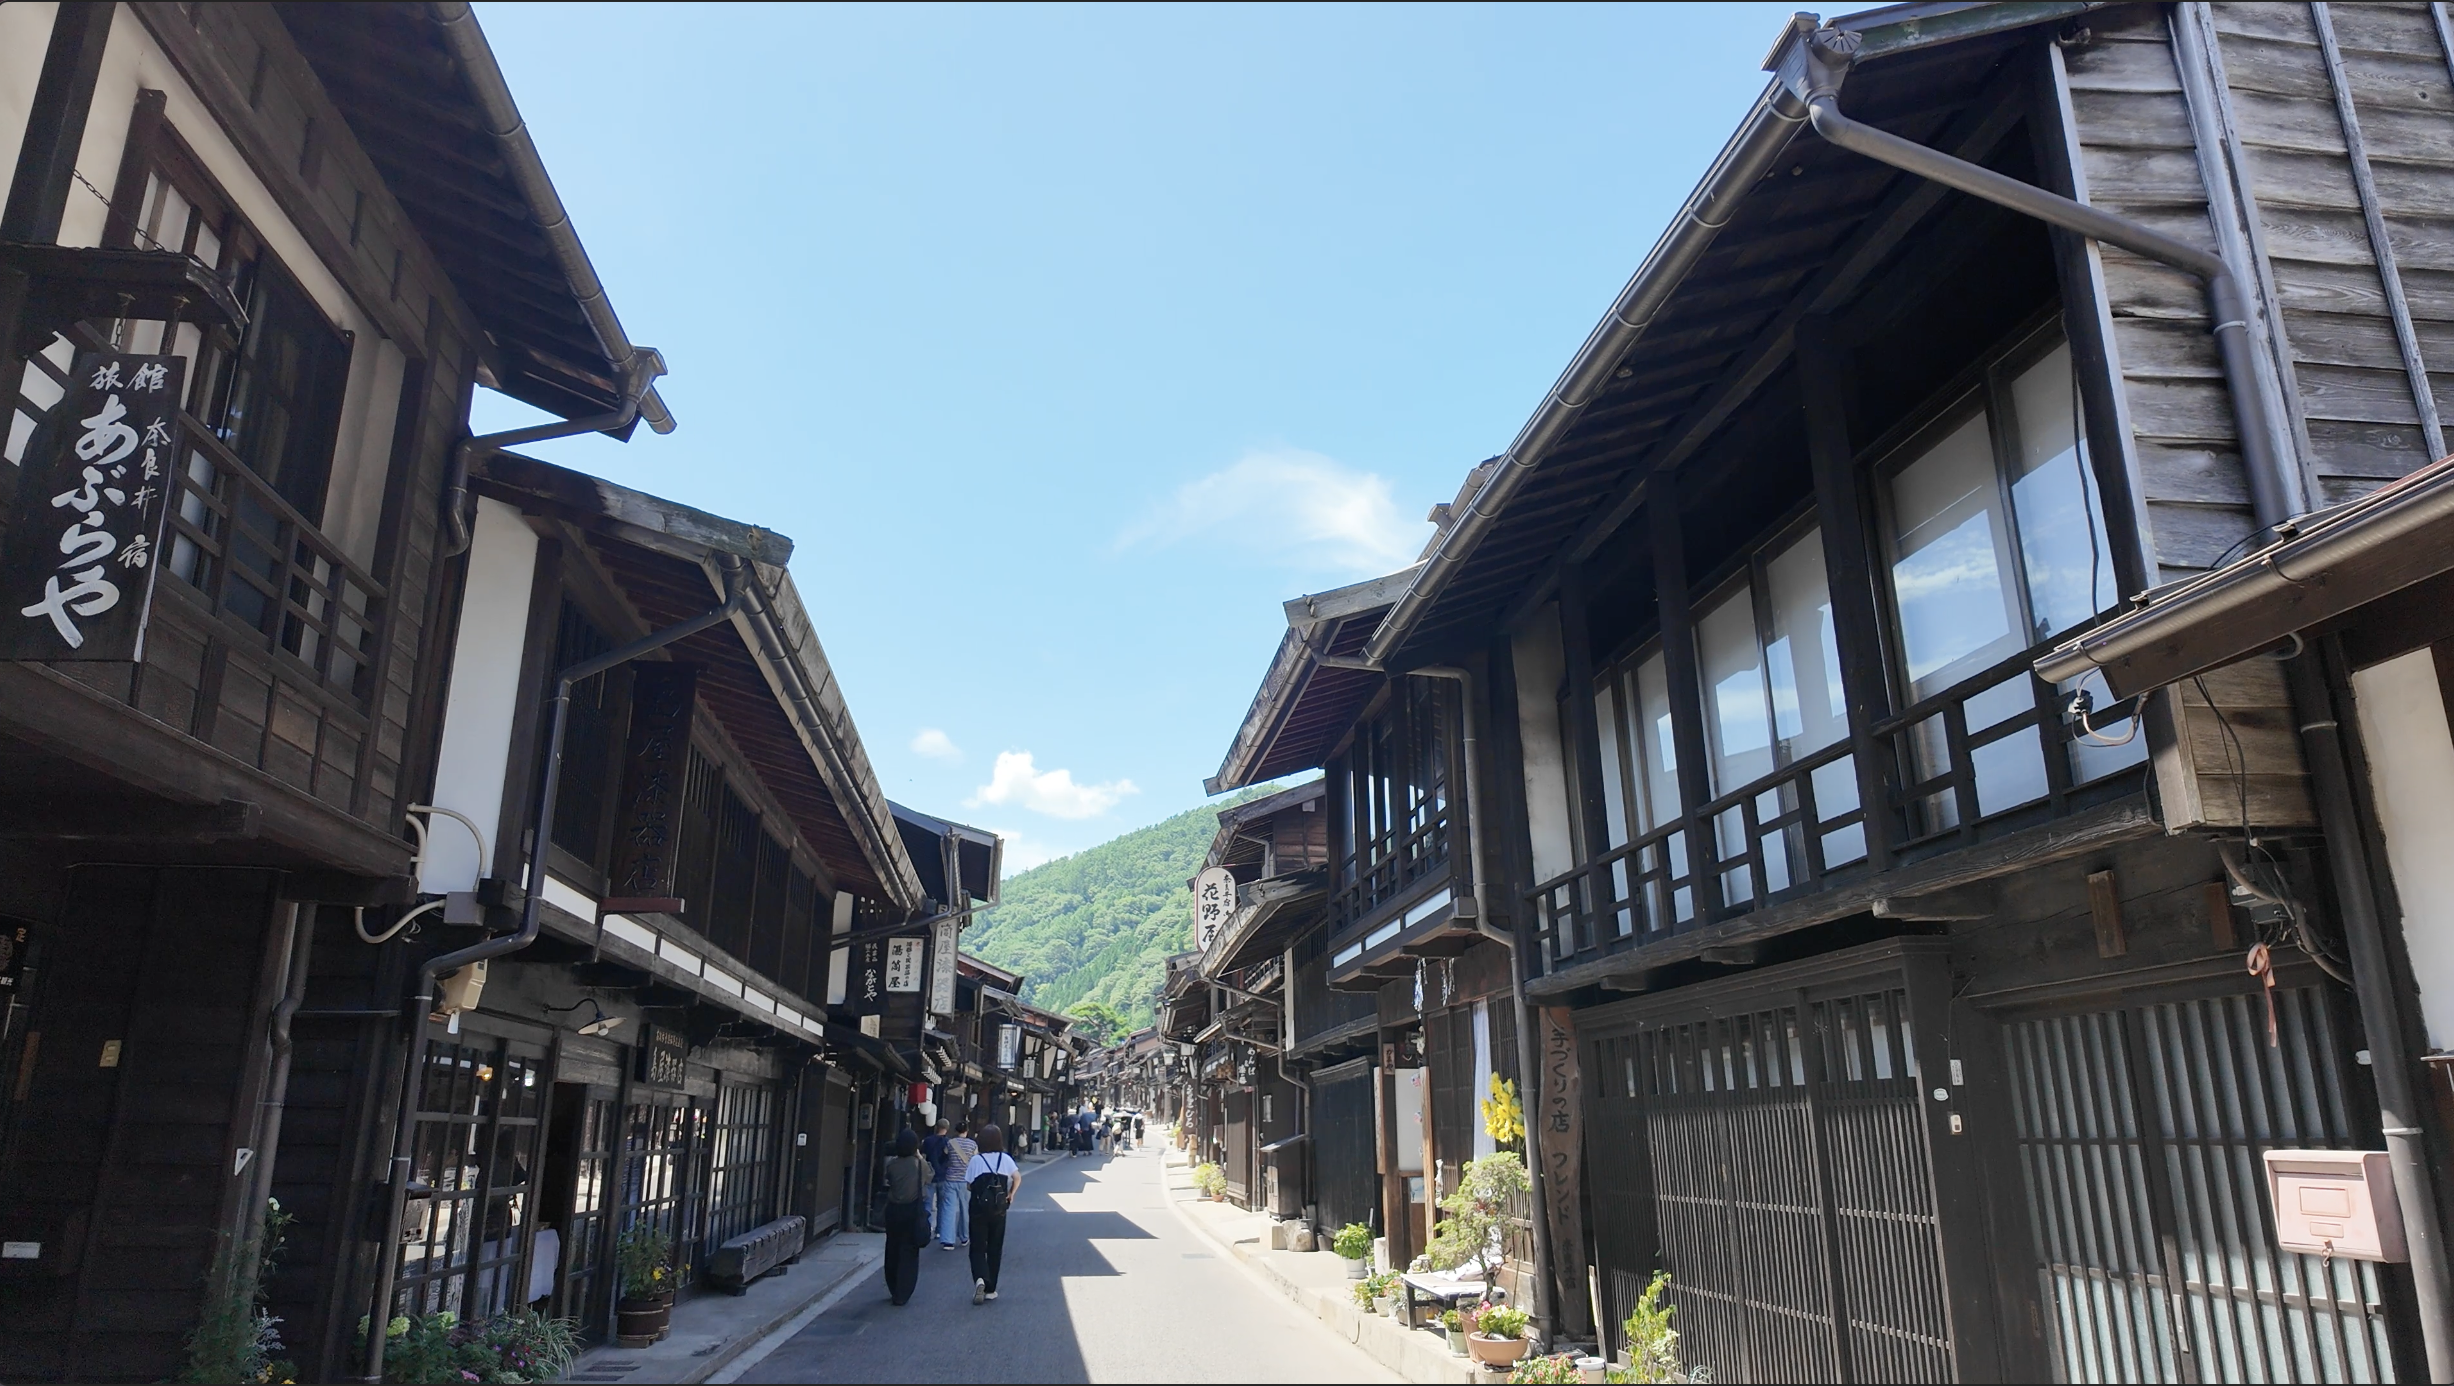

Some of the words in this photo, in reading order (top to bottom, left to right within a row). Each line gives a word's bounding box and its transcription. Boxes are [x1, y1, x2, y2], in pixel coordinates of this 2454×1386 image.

[90, 361, 168, 394] 旅館
[20, 394, 139, 649] あぶらや
[117, 416, 172, 569] 奈良井宿
[1201, 882, 1221, 943] 花野屋
[864, 968, 878, 1002] ながとや
[931, 905, 954, 1012] 筒屋漆器店
[1548, 1025, 1570, 1134] 手づくりの店
[1551, 1151, 1570, 1226] フレンド
